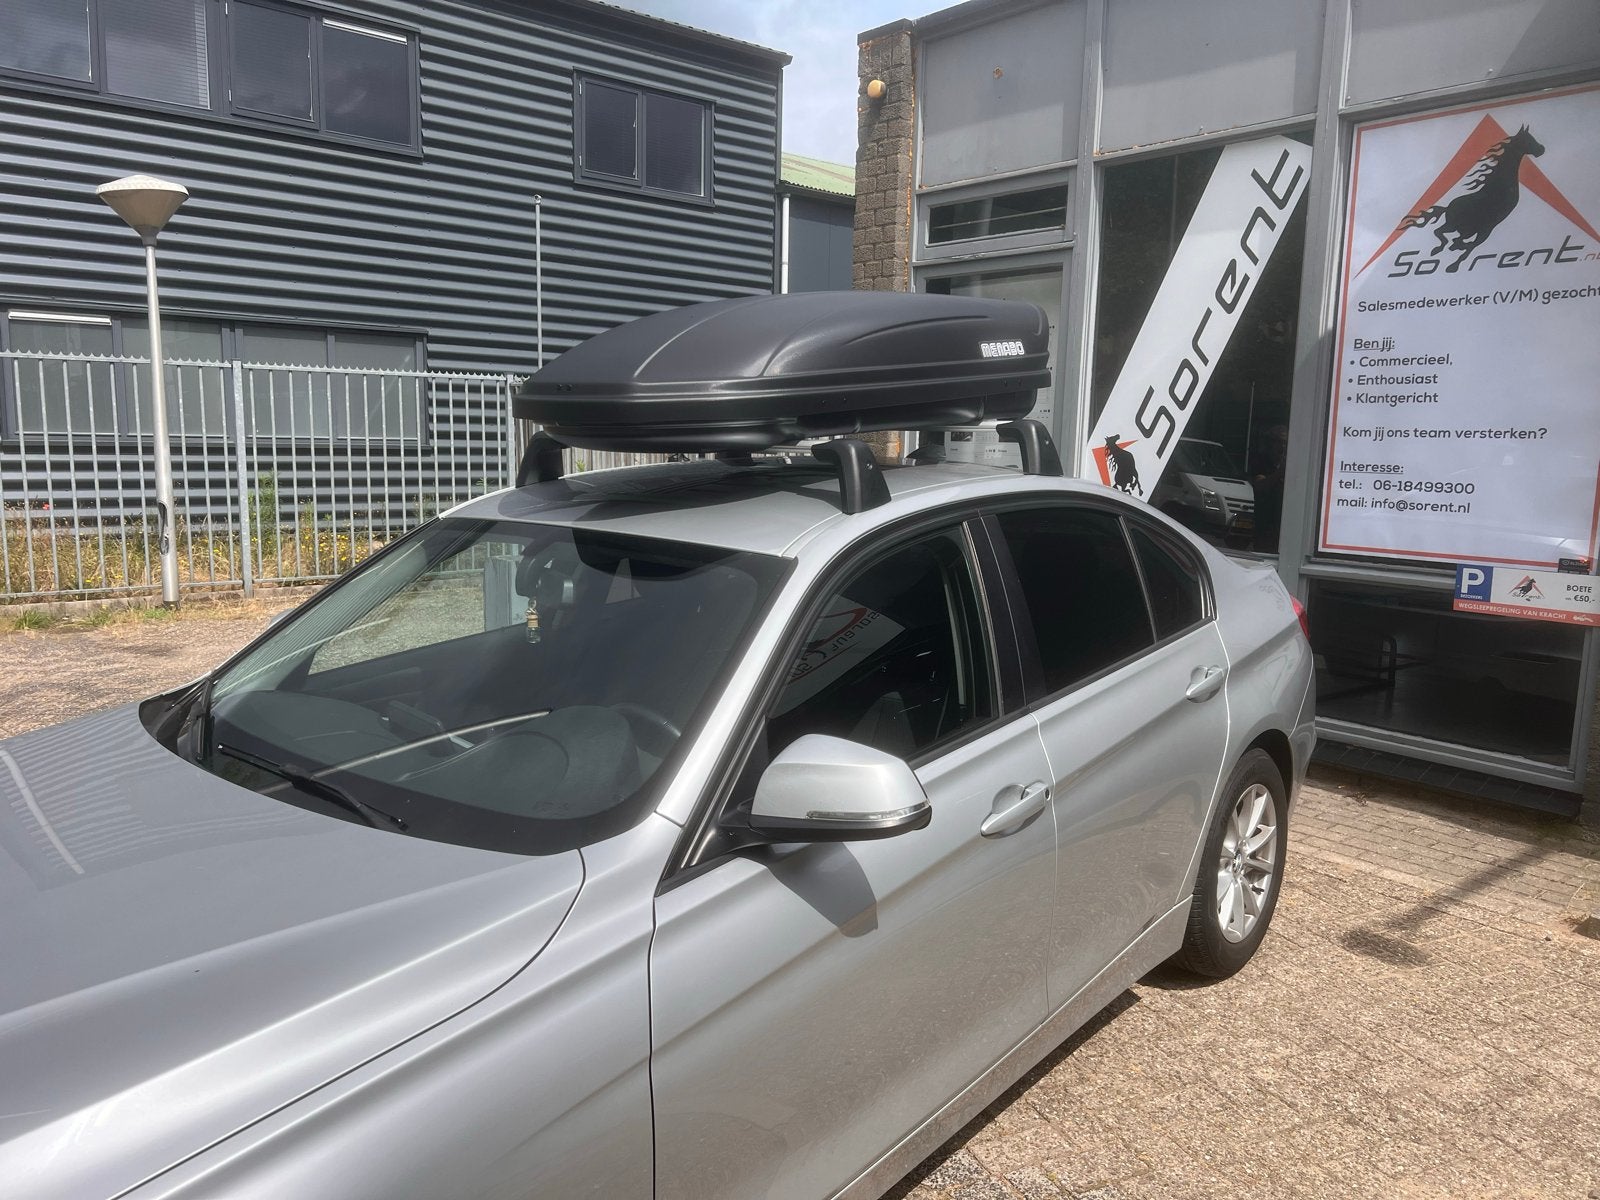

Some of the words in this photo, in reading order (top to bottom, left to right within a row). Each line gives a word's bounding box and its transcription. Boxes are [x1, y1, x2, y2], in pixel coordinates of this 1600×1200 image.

[1135, 148, 1304, 459] Sorent
[1357, 293, 1490, 313] Salesmedewerker
[1492, 287, 1539, 304] (V/M)
[980, 341, 1025, 358] MENABO
[1353, 338, 1379, 350] Ben
[1357, 373, 1439, 386] Enthousiast
[1355, 391, 1439, 408] Klantgericht
[1342, 426, 1372, 438] Kom
[1372, 426, 1385, 442] jij
[1386, 429, 1411, 439] ons
[1412, 427, 1451, 439] team
[1454, 427, 1548, 440] versterken?
[1340, 460, 1404, 474] Interesse:
[1338, 478, 1363, 490] tel.:
[1373, 479, 1475, 495] 06-18499300
[1336, 496, 1368, 508] mail:
[1370, 497, 1471, 514] info@sorent.nl
[1461, 567, 1485, 594] P
[1566, 584, 1593, 593] BOETE
[1522, 609, 1538, 617] VAN
[1539, 611, 1567, 620] KRACHT
